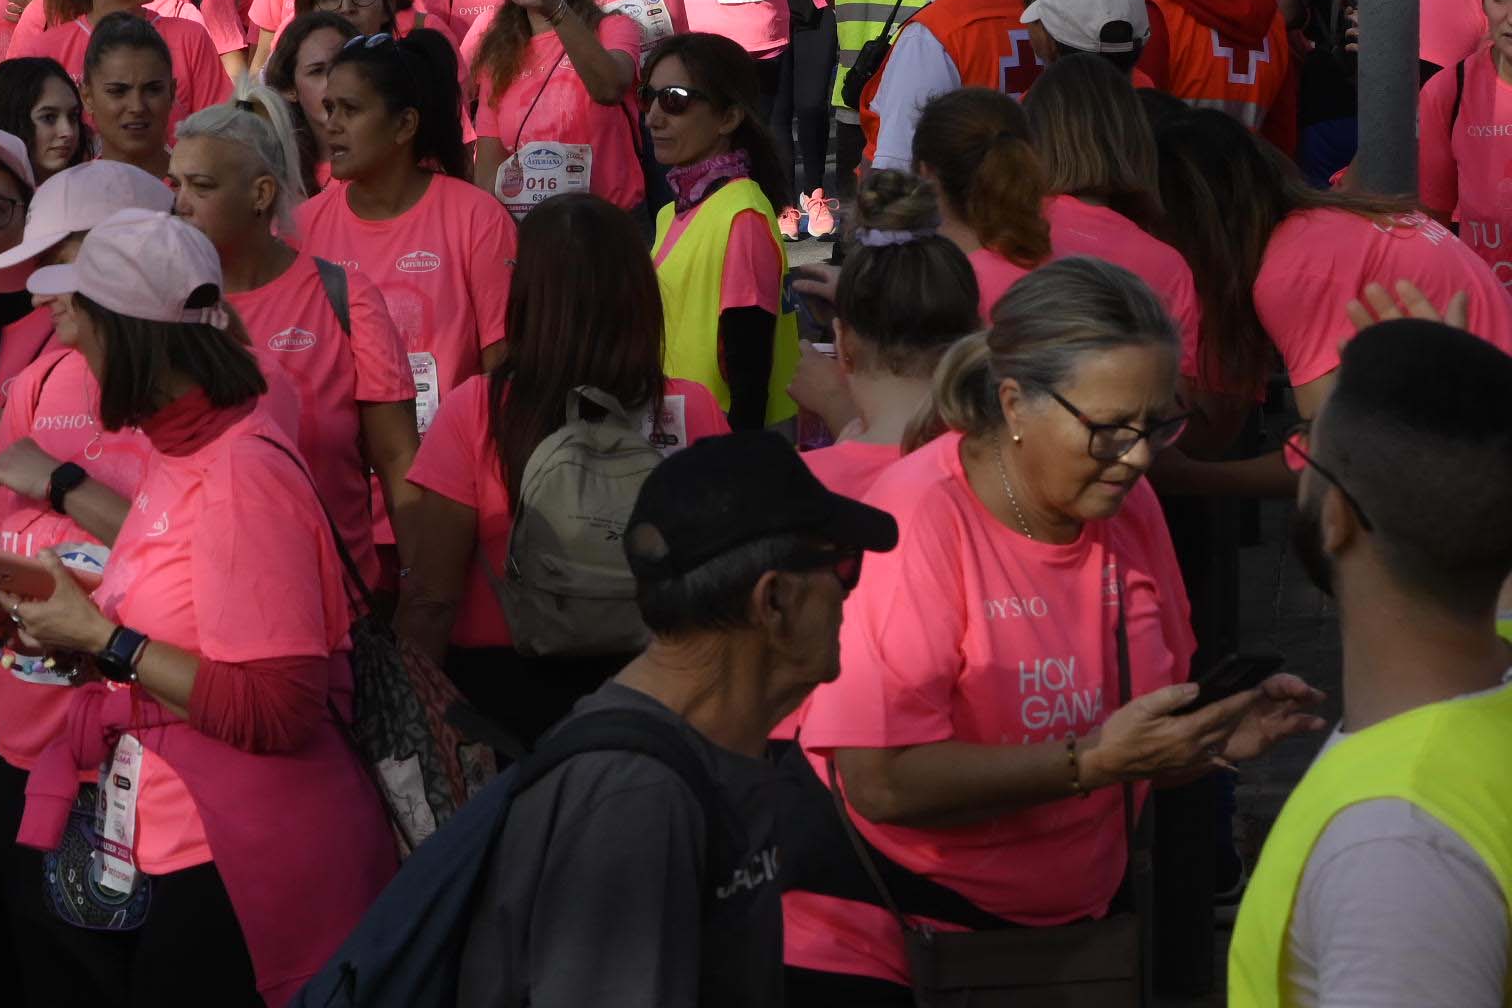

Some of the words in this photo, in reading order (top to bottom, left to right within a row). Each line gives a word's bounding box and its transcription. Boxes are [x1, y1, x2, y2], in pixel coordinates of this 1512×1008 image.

[526, 158, 561, 166] ASTURIANA
[526, 177, 557, 190] 016
[1469, 221, 1501, 249] TU
[399, 259, 438, 269] ASTURIANA
[271, 336, 314, 347] ASTURIANA
[34, 414, 87, 430] OYSHO
[1018, 655, 1076, 694] HOY
